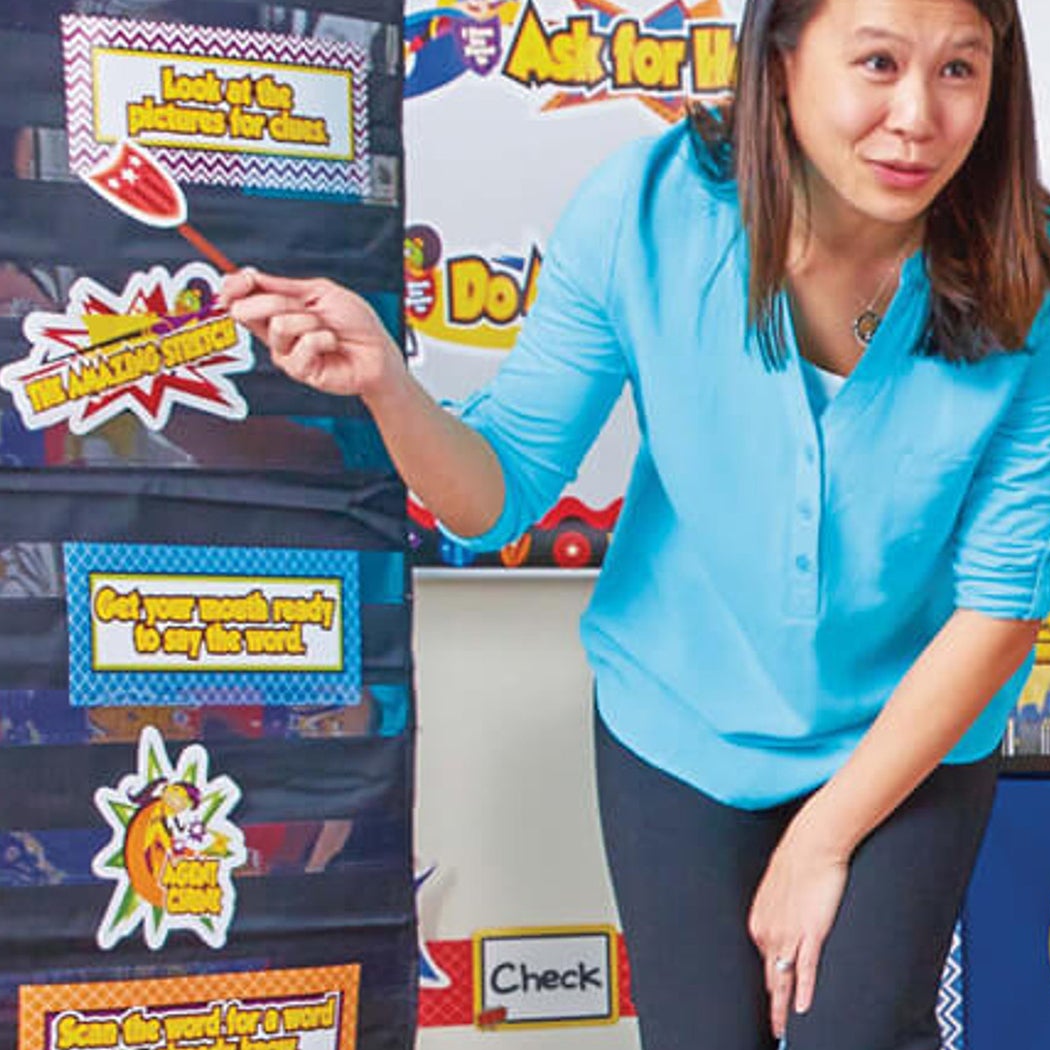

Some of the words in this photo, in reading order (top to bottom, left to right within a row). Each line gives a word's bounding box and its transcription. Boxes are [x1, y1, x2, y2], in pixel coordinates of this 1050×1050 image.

[501, 0, 609, 88] Ask
[610, 18, 687, 89] for
[685, 23, 738, 93] H
[160, 66, 222, 104] Look
[223, 74, 252, 107] at
[254, 74, 295, 111] the
[127, 95, 227, 137] pictures
[228, 105, 267, 140] for
[447, 254, 523, 326] Do
[25, 374, 68, 413] THE
[67, 342, 163, 401] AMAZING
[94, 586, 142, 623] Get
[141, 594, 197, 626] your
[196, 589, 270, 623] mouth
[271, 590, 336, 631] ready
[133, 621, 161, 654] to
[162, 626, 203, 660] say
[203, 622, 242, 655] the
[244, 622, 307, 655] word.
[490, 961, 602, 995] Check
[55, 1015, 120, 1049] Scan
[120, 1010, 161, 1046] the
[161, 1003, 222, 1042] word
[224, 1003, 261, 1036] for
[262, 1006, 279, 1034] a
[281, 995, 337, 1031] word
